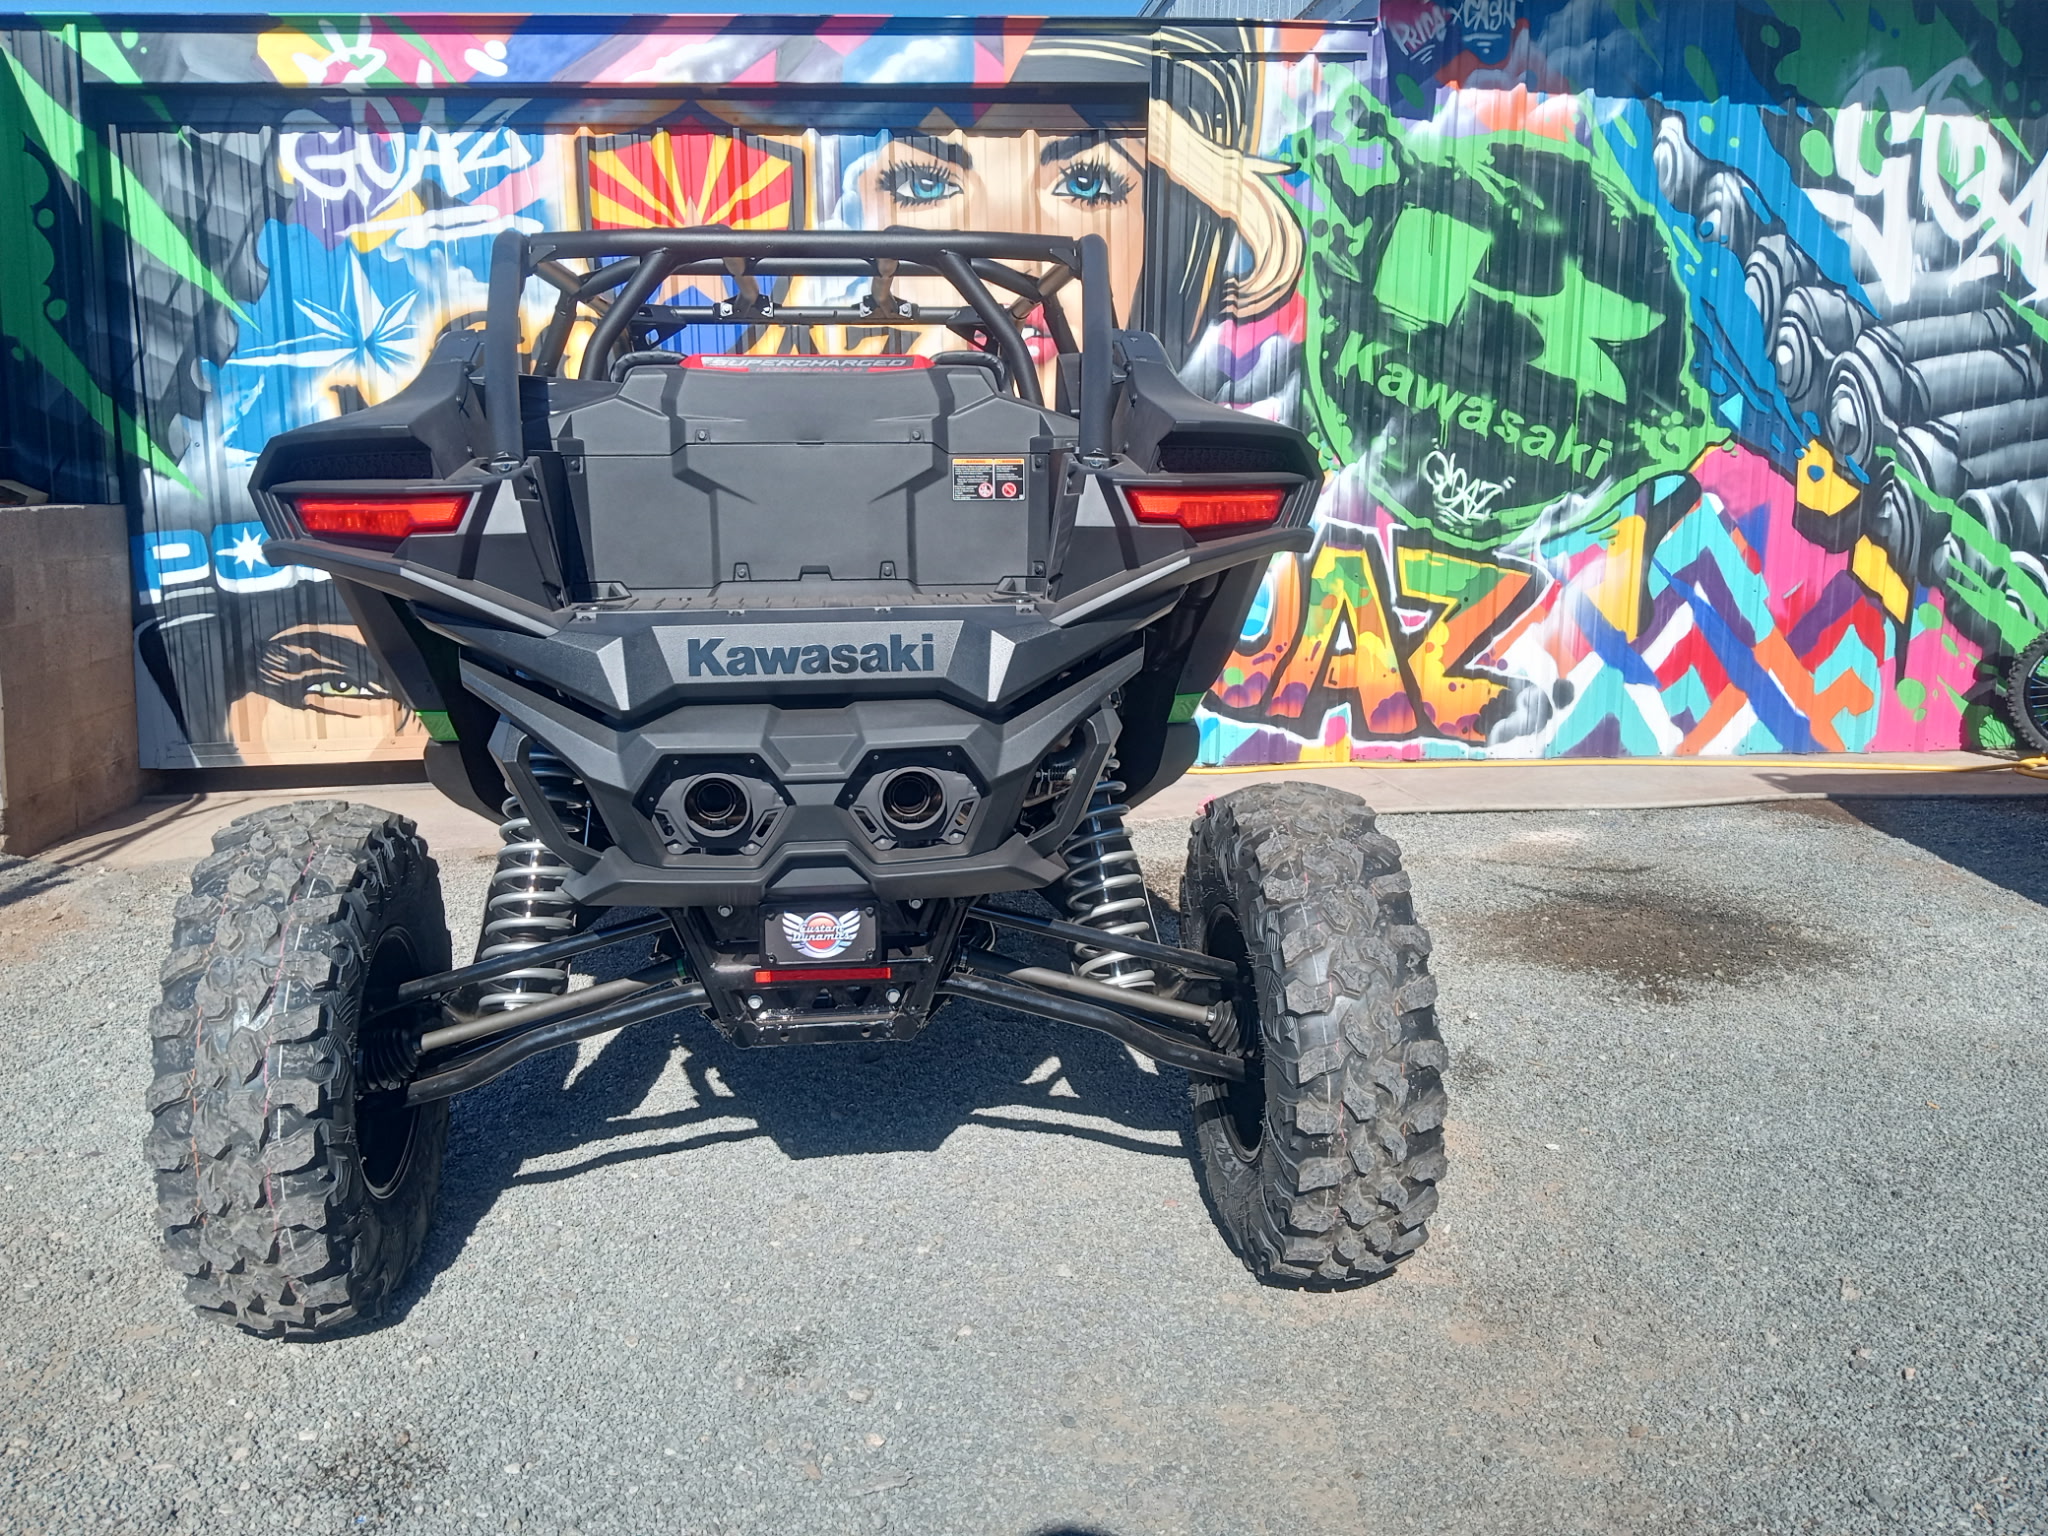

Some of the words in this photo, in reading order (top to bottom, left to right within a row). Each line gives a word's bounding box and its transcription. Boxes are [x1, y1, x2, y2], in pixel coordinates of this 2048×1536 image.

[1334, 330, 1614, 480] Kawasaki
[687, 633, 935, 677] Kawasaki
[792, 931, 852, 942] Dynamics
[799, 923, 844, 933] Custom
